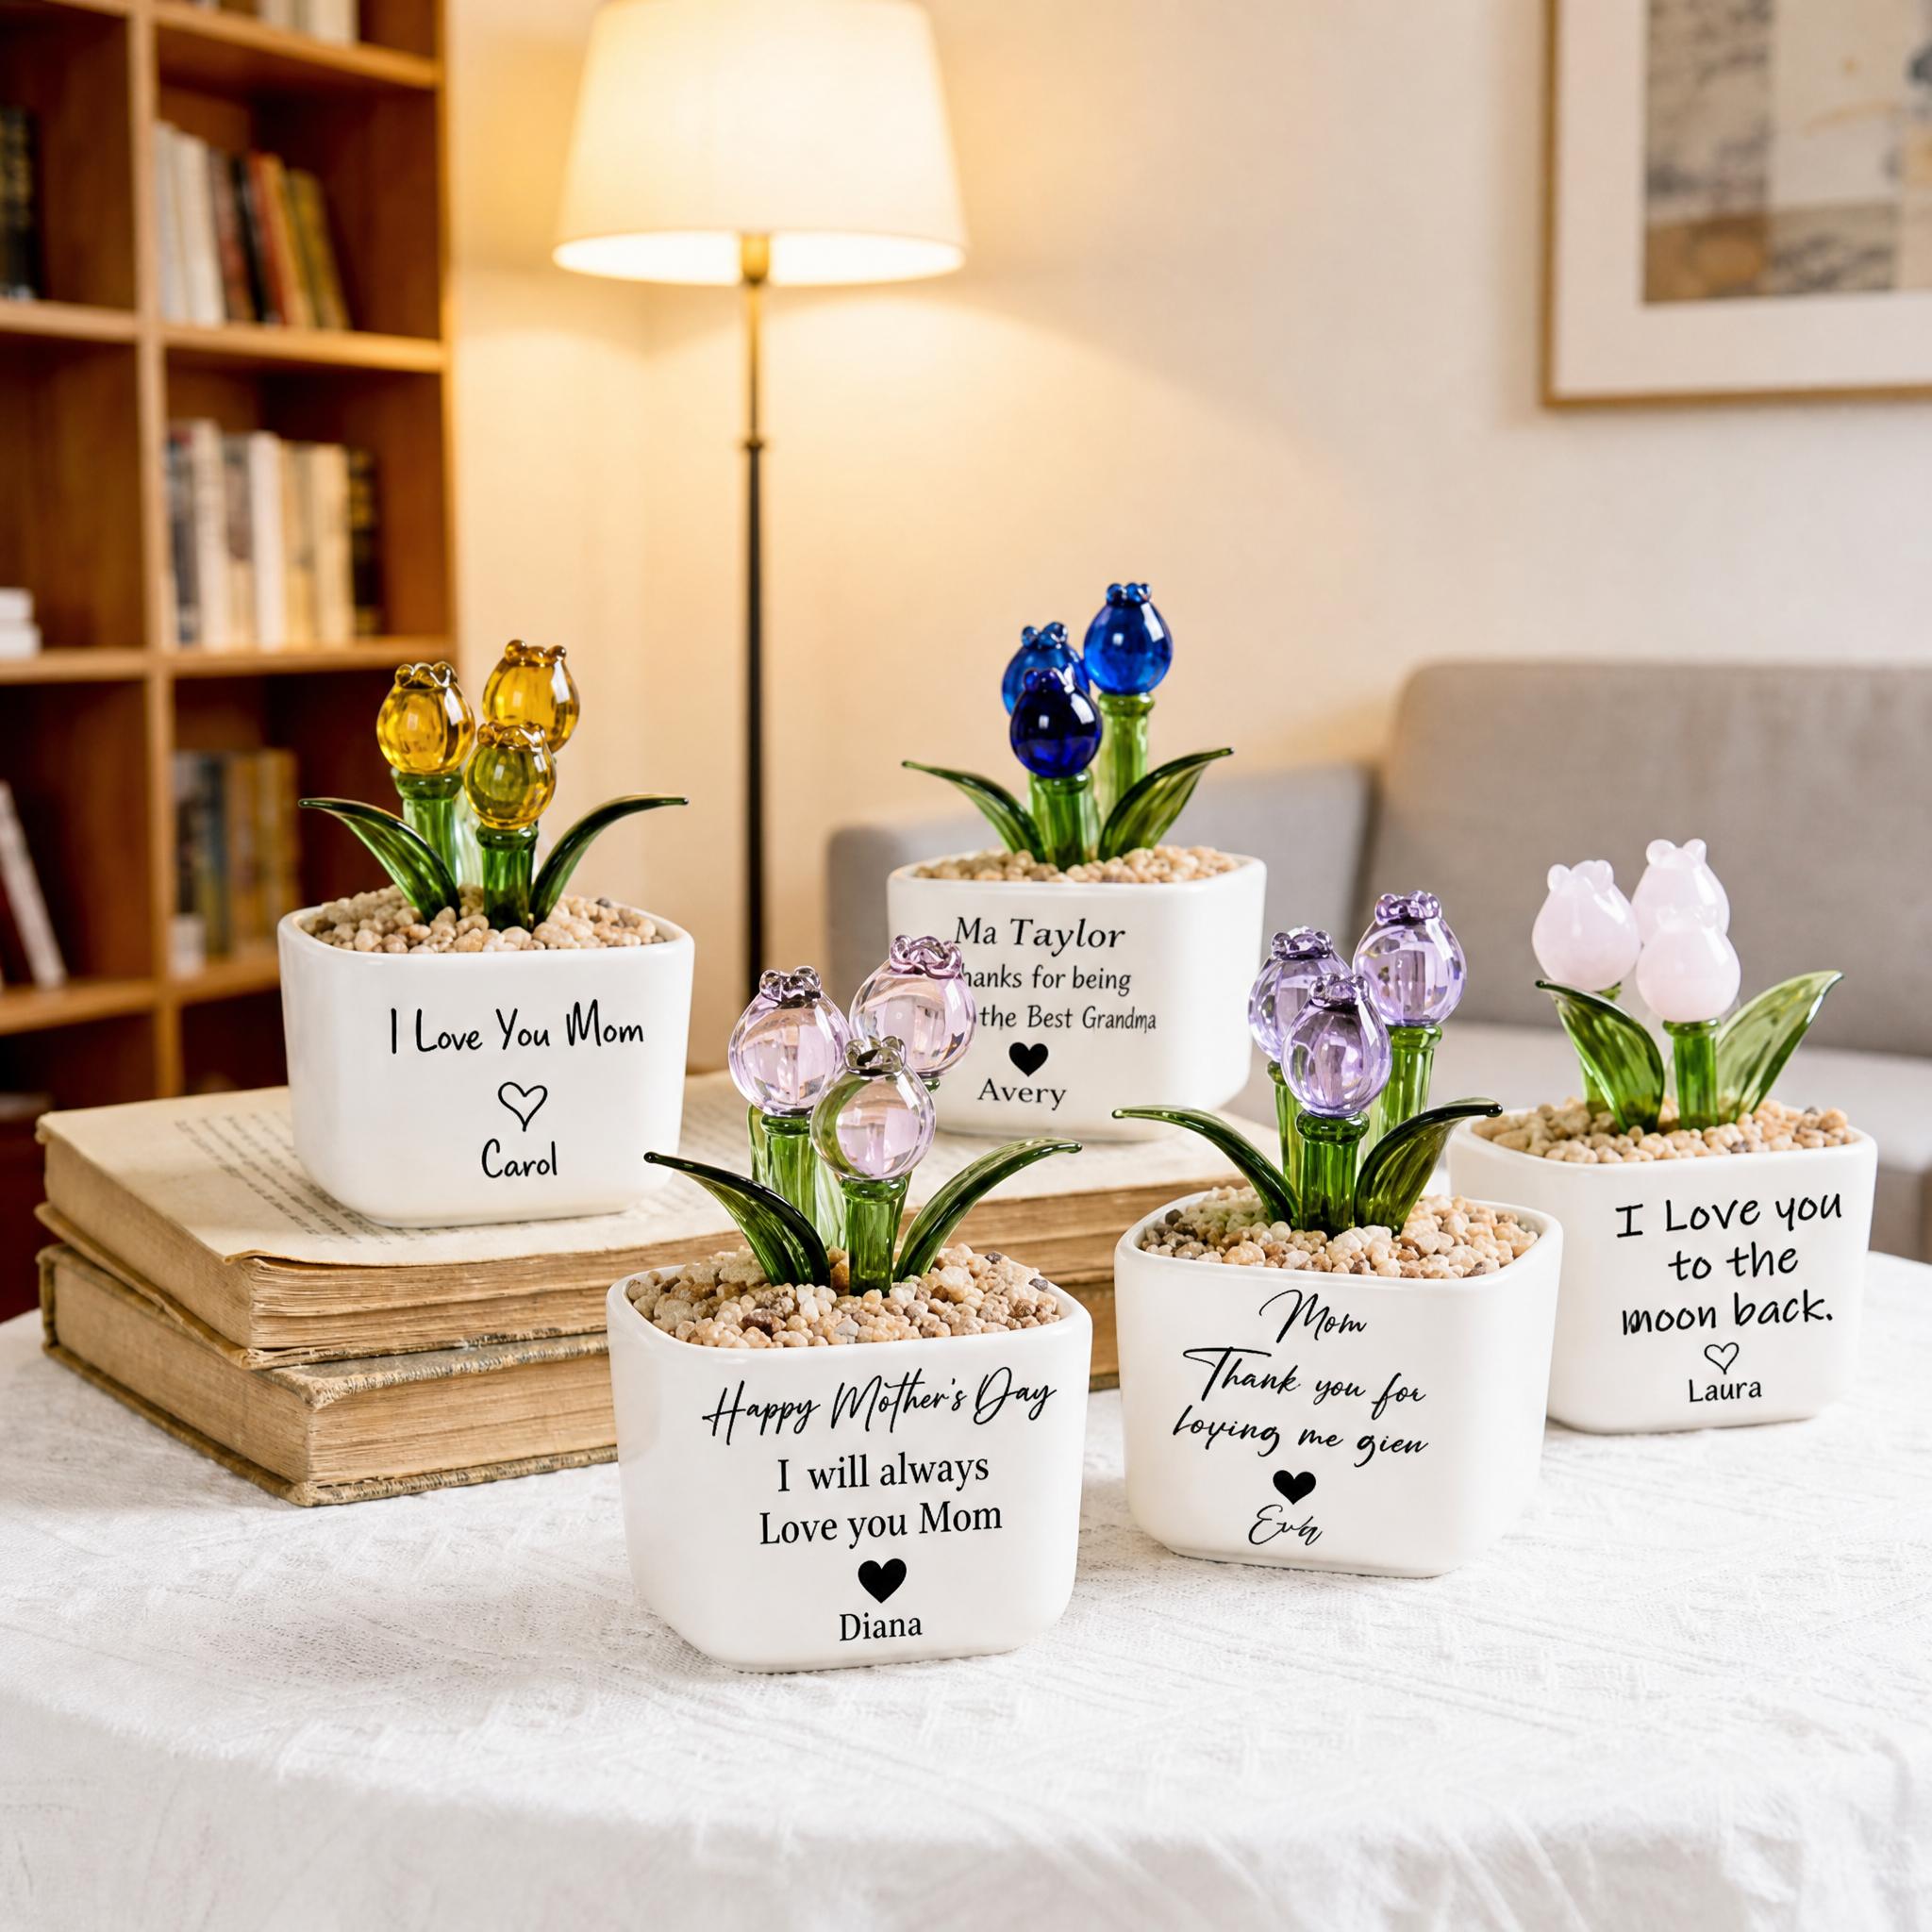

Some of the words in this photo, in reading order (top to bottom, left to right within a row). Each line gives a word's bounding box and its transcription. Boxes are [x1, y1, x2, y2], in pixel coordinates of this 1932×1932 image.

[954, 916, 997, 945] Ma
[1009, 917, 1126, 958] Taylor
[960, 962, 1023, 989] hanks
[1031, 963, 1067, 990] for
[1072, 965, 1133, 997] being
[390, 1007, 398, 1055] I
[414, 1008, 484, 1053] Love
[494, 1008, 552, 1051] You
[565, 997, 645, 1047] Mom
[977, 1003, 1018, 1029] the
[1026, 1004, 1074, 1029] Best
[1081, 1005, 1158, 1034] Grandma
[976, 1077, 1068, 1111] Avery
[480, 1138, 558, 1179] Carol
[1614, 1202, 1645, 1240] I
[1664, 1198, 1762, 1232] Love
[1774, 1192, 1843, 1232] you
[1667, 1250, 1713, 1282] to
[1724, 1241, 1800, 1278] the
[1257, 1289, 1369, 1344] Mom
[1621, 1306, 1718, 1336] moon
[1732, 1289, 1834, 1327] back.
[1181, 1345, 1302, 1403] Thank
[1312, 1379, 1368, 1406] you
[1370, 1372, 1427, 1421] for
[1688, 1378, 1763, 1404] Laura
[700, 1374, 822, 1446] Happy
[829, 1366, 969, 1434] Mother's
[972, 1365, 1058, 1425] Day
[1296, 1427, 1345, 1449] me
[776, 1458, 791, 1492] I
[807, 1453, 870, 1491] will
[879, 1451, 991, 1492] always
[758, 1511, 839, 1545] Love
[846, 1514, 909, 1550] you
[918, 1500, 1004, 1535] Mom
[838, 1611, 924, 1642] Diana
